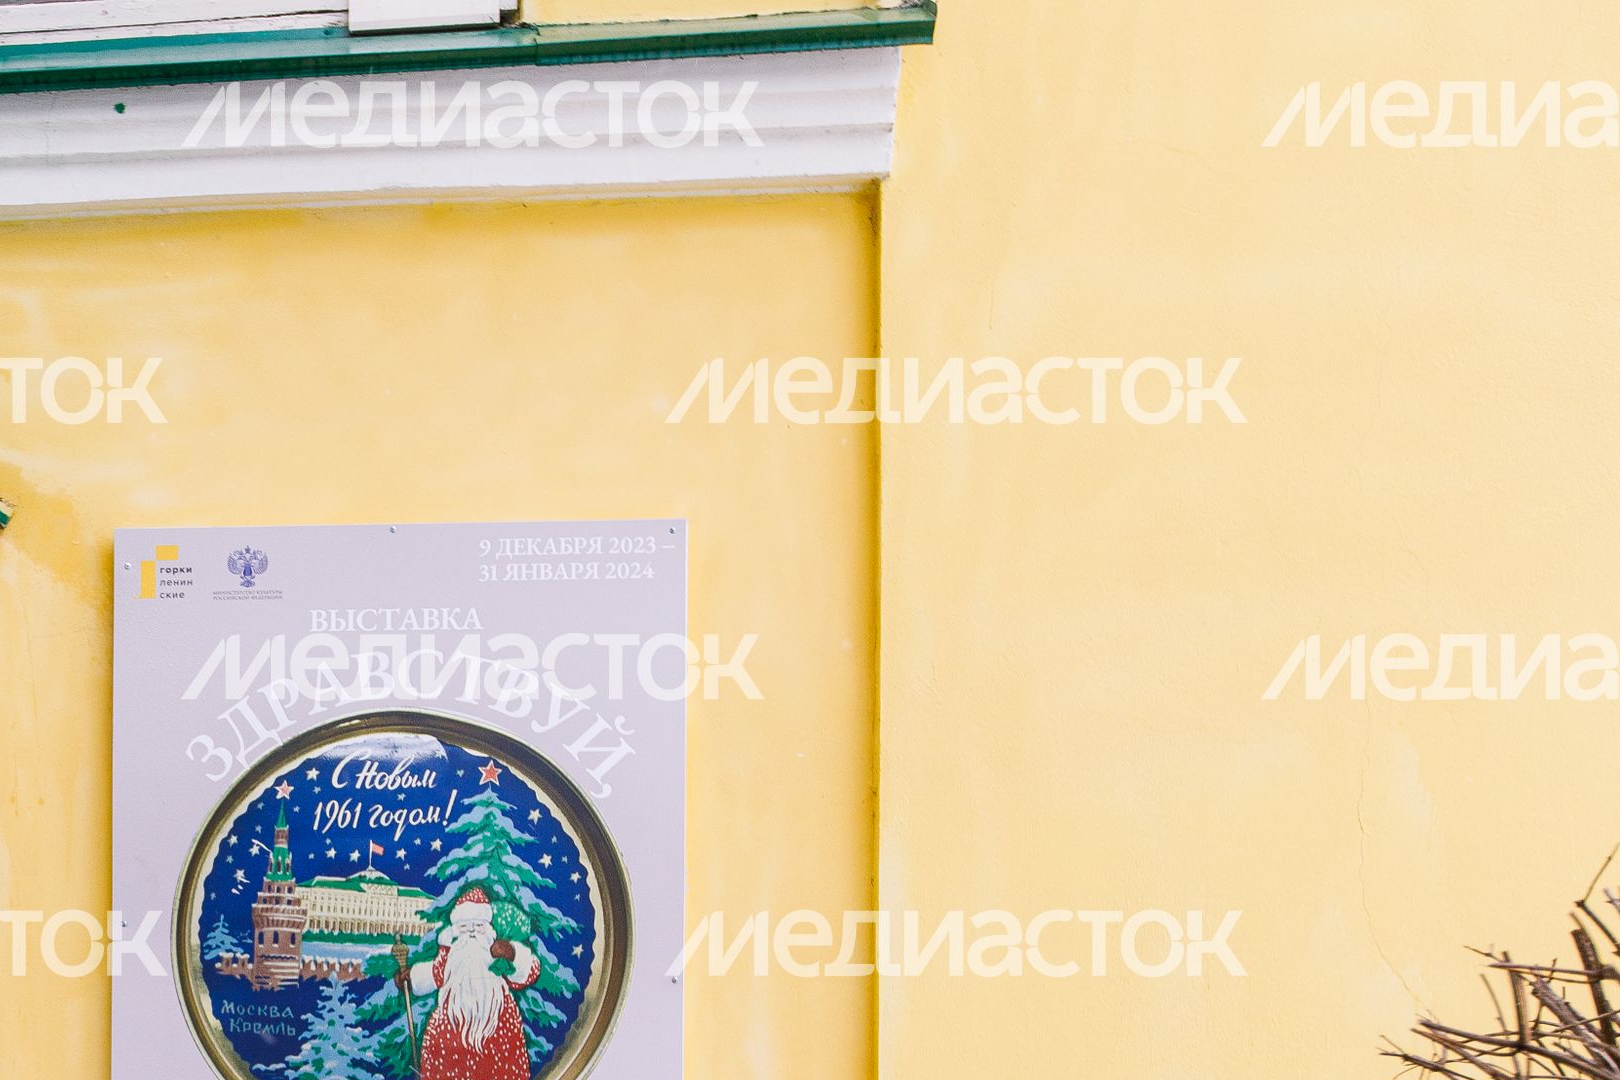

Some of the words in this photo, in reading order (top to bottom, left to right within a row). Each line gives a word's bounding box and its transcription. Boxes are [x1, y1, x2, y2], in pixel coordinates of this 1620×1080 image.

[479, 538, 492, 557] 9
[495, 536, 603, 560] ДЕКАБРЯ
[608, 536, 656, 554] 2023
[159, 566, 193, 575] горки
[479, 564, 497, 582] 31
[502, 562, 600, 582] ЯНВАРЯ
[605, 561, 655, 580] 2024
[159, 579, 194, 587] ленин
[309, 606, 484, 633] ВЫСТАВКА
[331, 750, 371, 789] С
[355, 754, 438, 791] Новым
[312, 798, 363, 834] 1961
[368, 789, 458, 842] годом!
